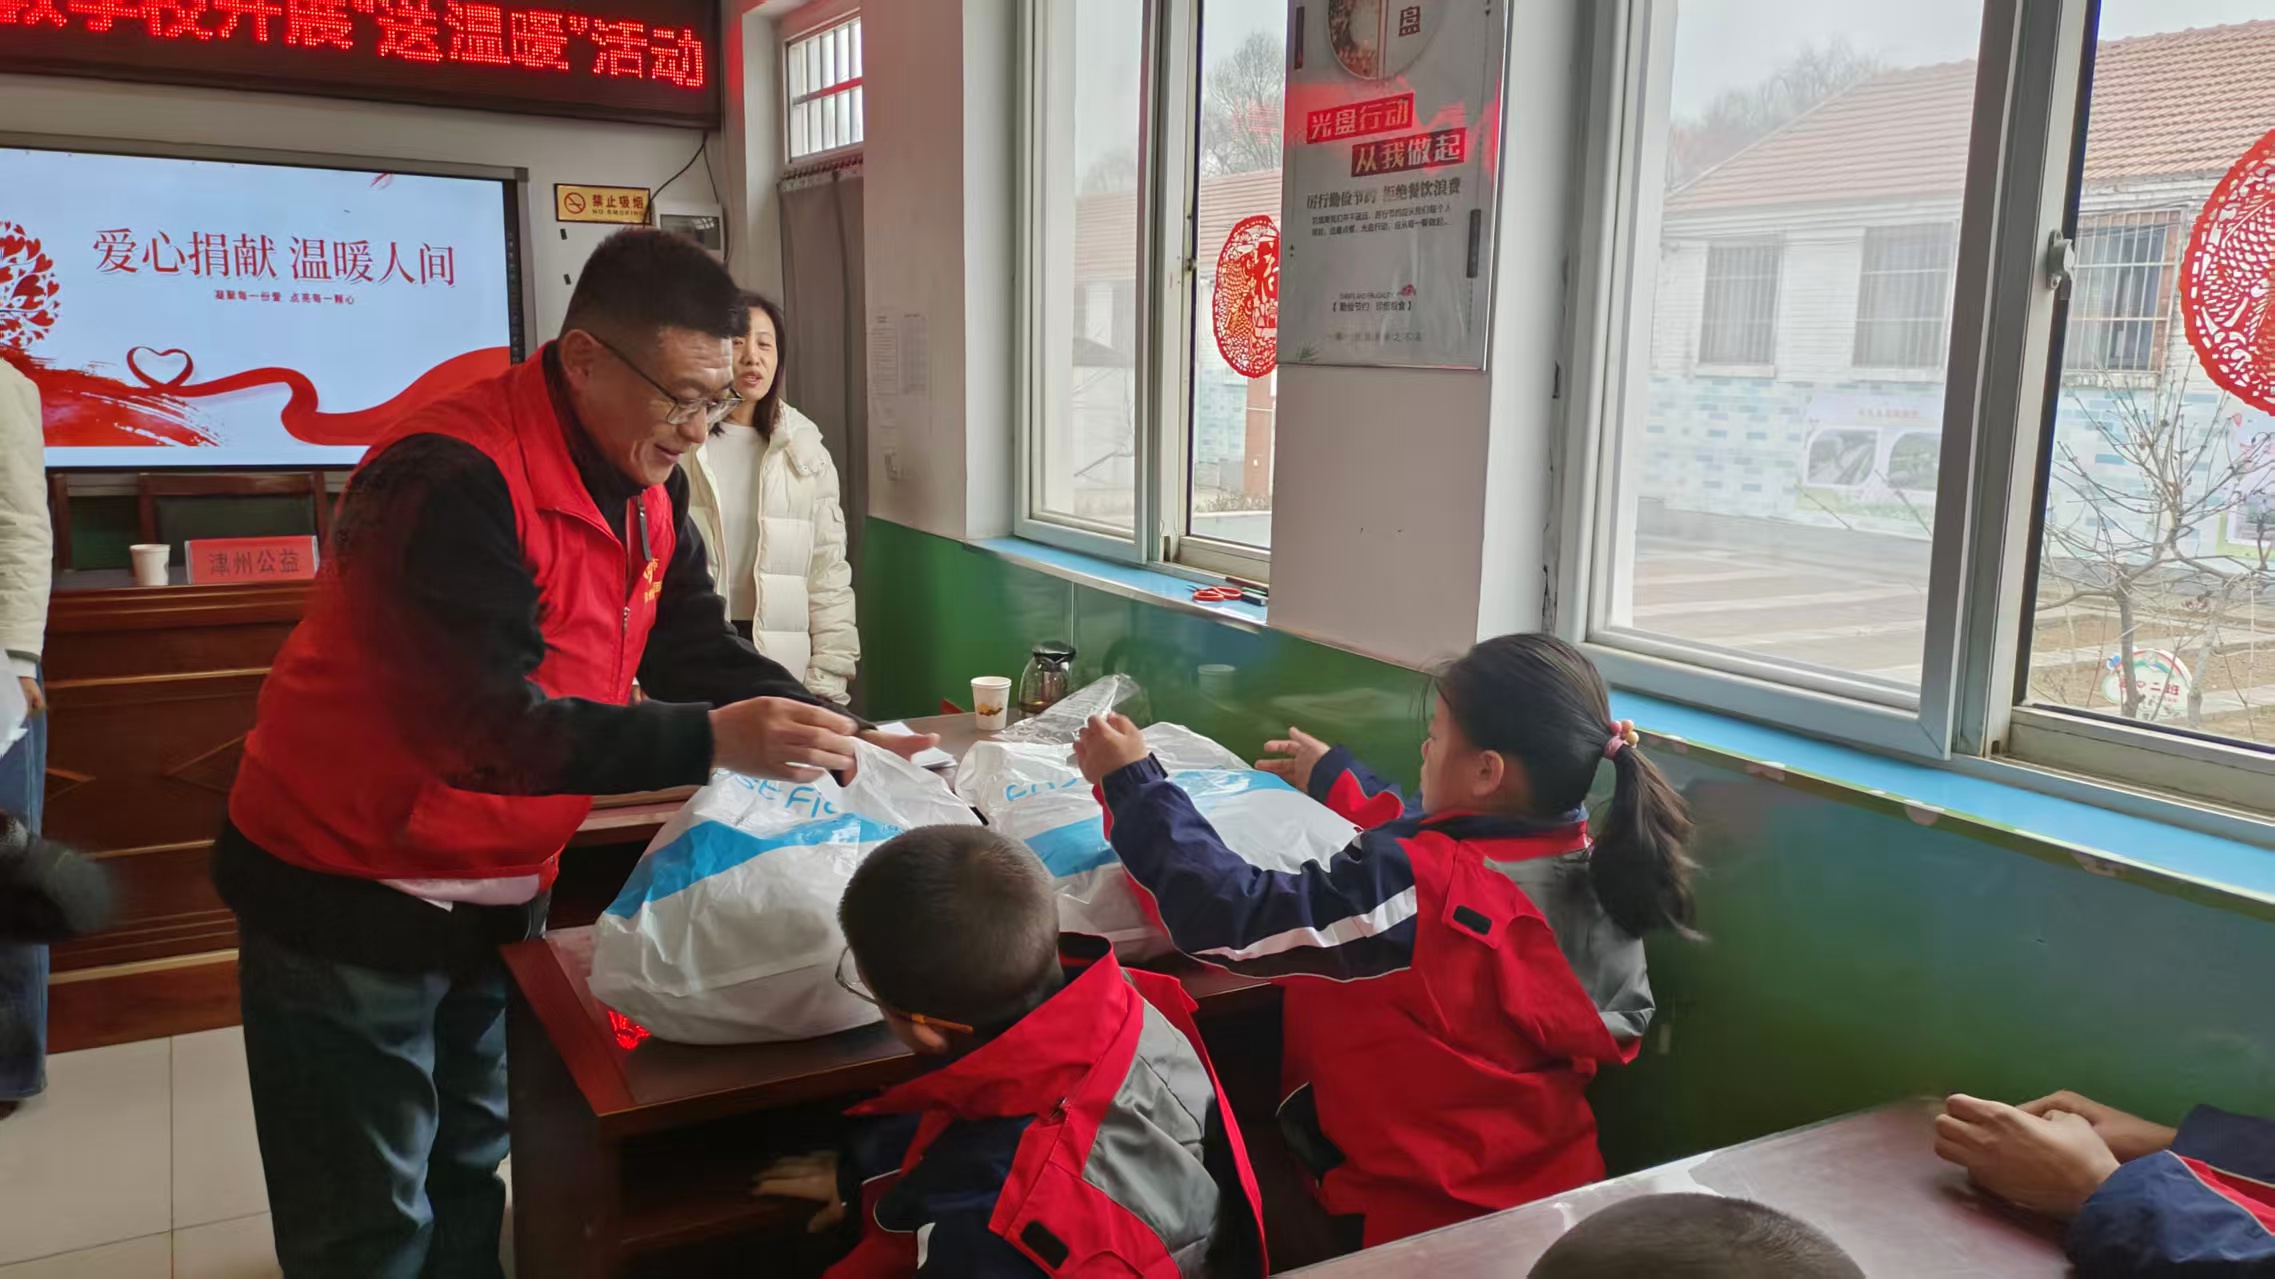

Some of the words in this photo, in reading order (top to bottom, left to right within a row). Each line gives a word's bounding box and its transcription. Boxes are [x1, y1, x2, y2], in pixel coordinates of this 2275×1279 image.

[1311, 99, 1409, 140] 光盘行动
[1355, 134, 1461, 173] 从我做起
[592, 194, 644, 209] 禁止吸烟
[93, 228, 278, 279] 爱心捐献
[289, 235, 455, 287] 温暖人间
[209, 548, 300, 576] 津州公益
